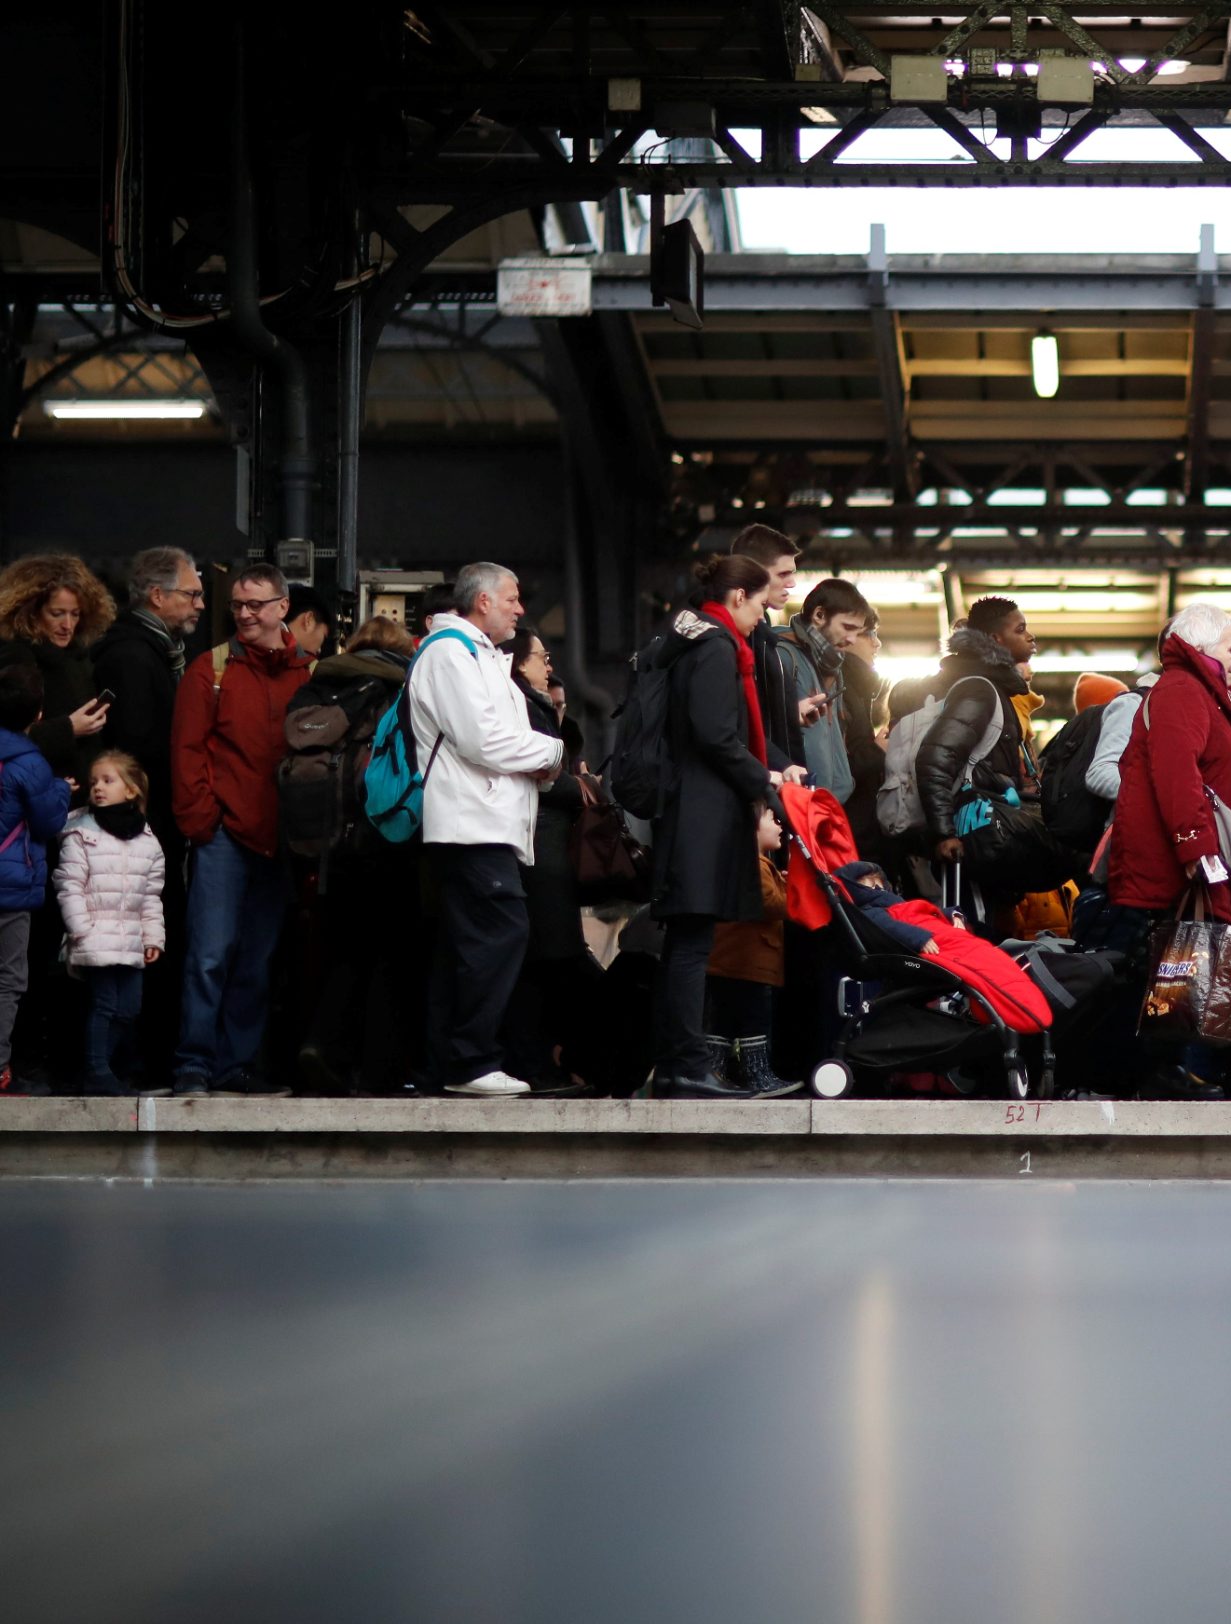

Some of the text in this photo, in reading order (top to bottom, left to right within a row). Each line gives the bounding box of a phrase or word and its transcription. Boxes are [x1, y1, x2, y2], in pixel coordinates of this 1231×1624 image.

[953, 798, 994, 838] IKE
[1004, 1102, 1053, 1124] 52 T
[1018, 1150, 1033, 1174] 1
